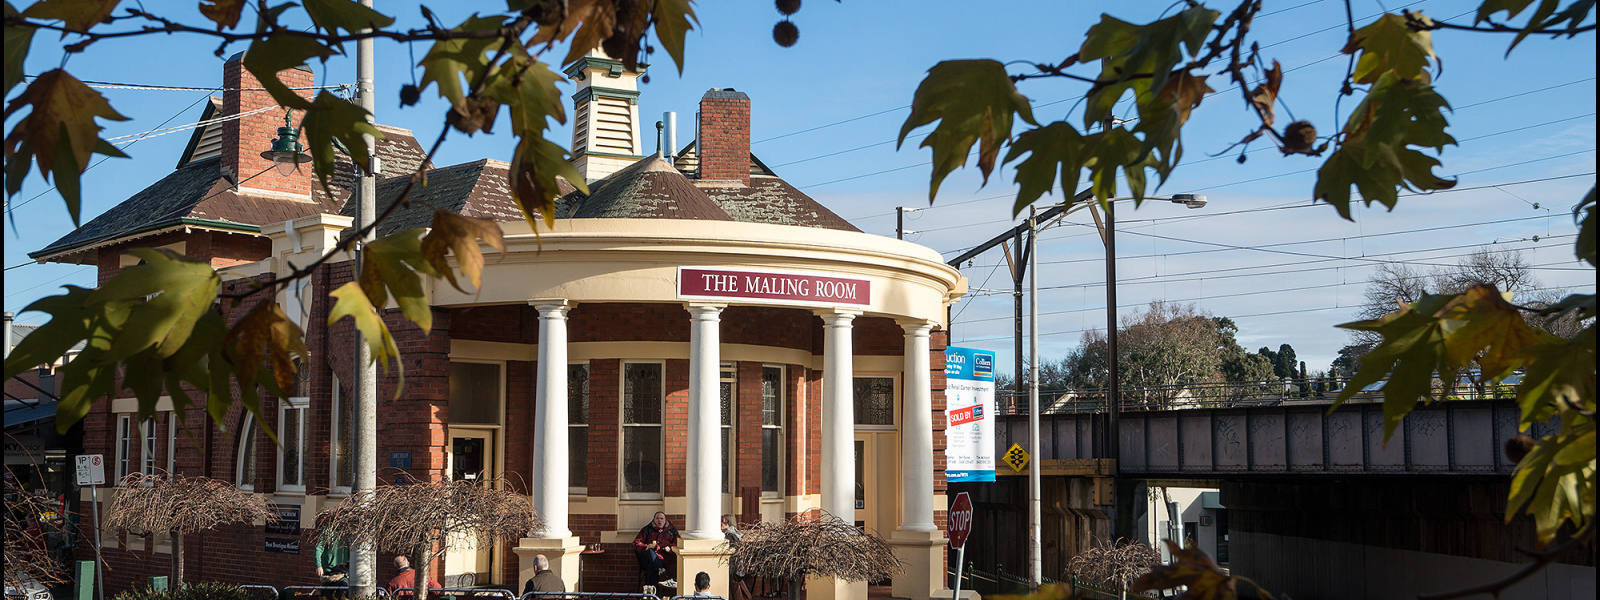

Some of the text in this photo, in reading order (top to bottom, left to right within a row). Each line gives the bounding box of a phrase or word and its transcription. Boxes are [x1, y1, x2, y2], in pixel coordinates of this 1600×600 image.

[701, 273, 857, 300] THE MALING ROOM
[950, 410, 971, 422] SOLD BY
[950, 510, 970, 531] STOP
